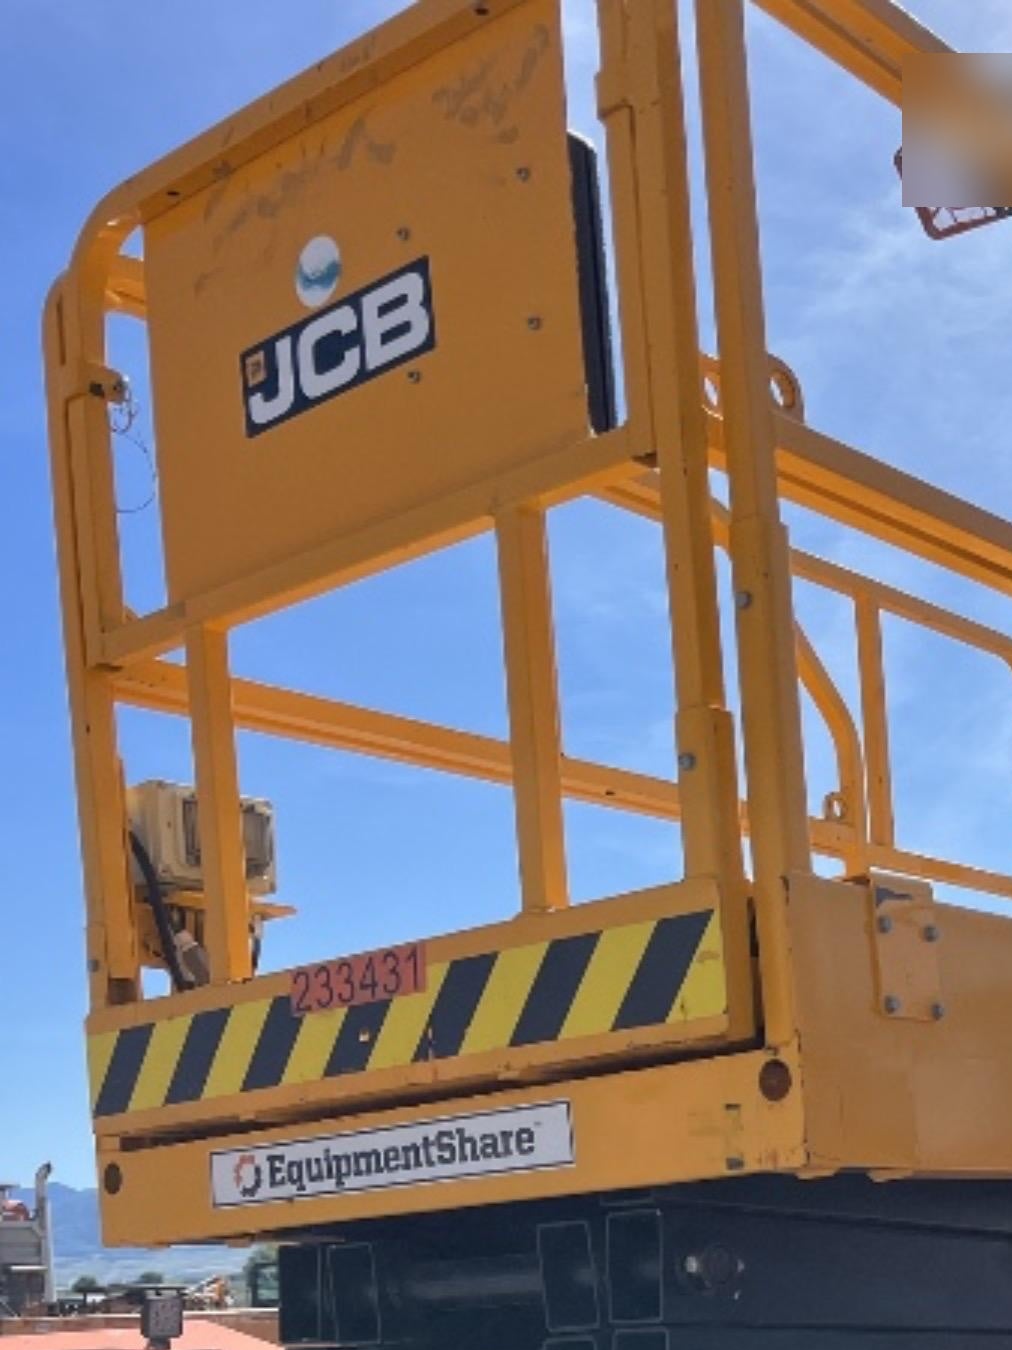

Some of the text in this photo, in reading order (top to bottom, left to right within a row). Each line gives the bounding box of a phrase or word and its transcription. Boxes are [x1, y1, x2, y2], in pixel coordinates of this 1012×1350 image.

[249, 271, 430, 424] JCB
[293, 946, 418, 1011] 233431
[266, 1126, 535, 1192] EquipmentShare
